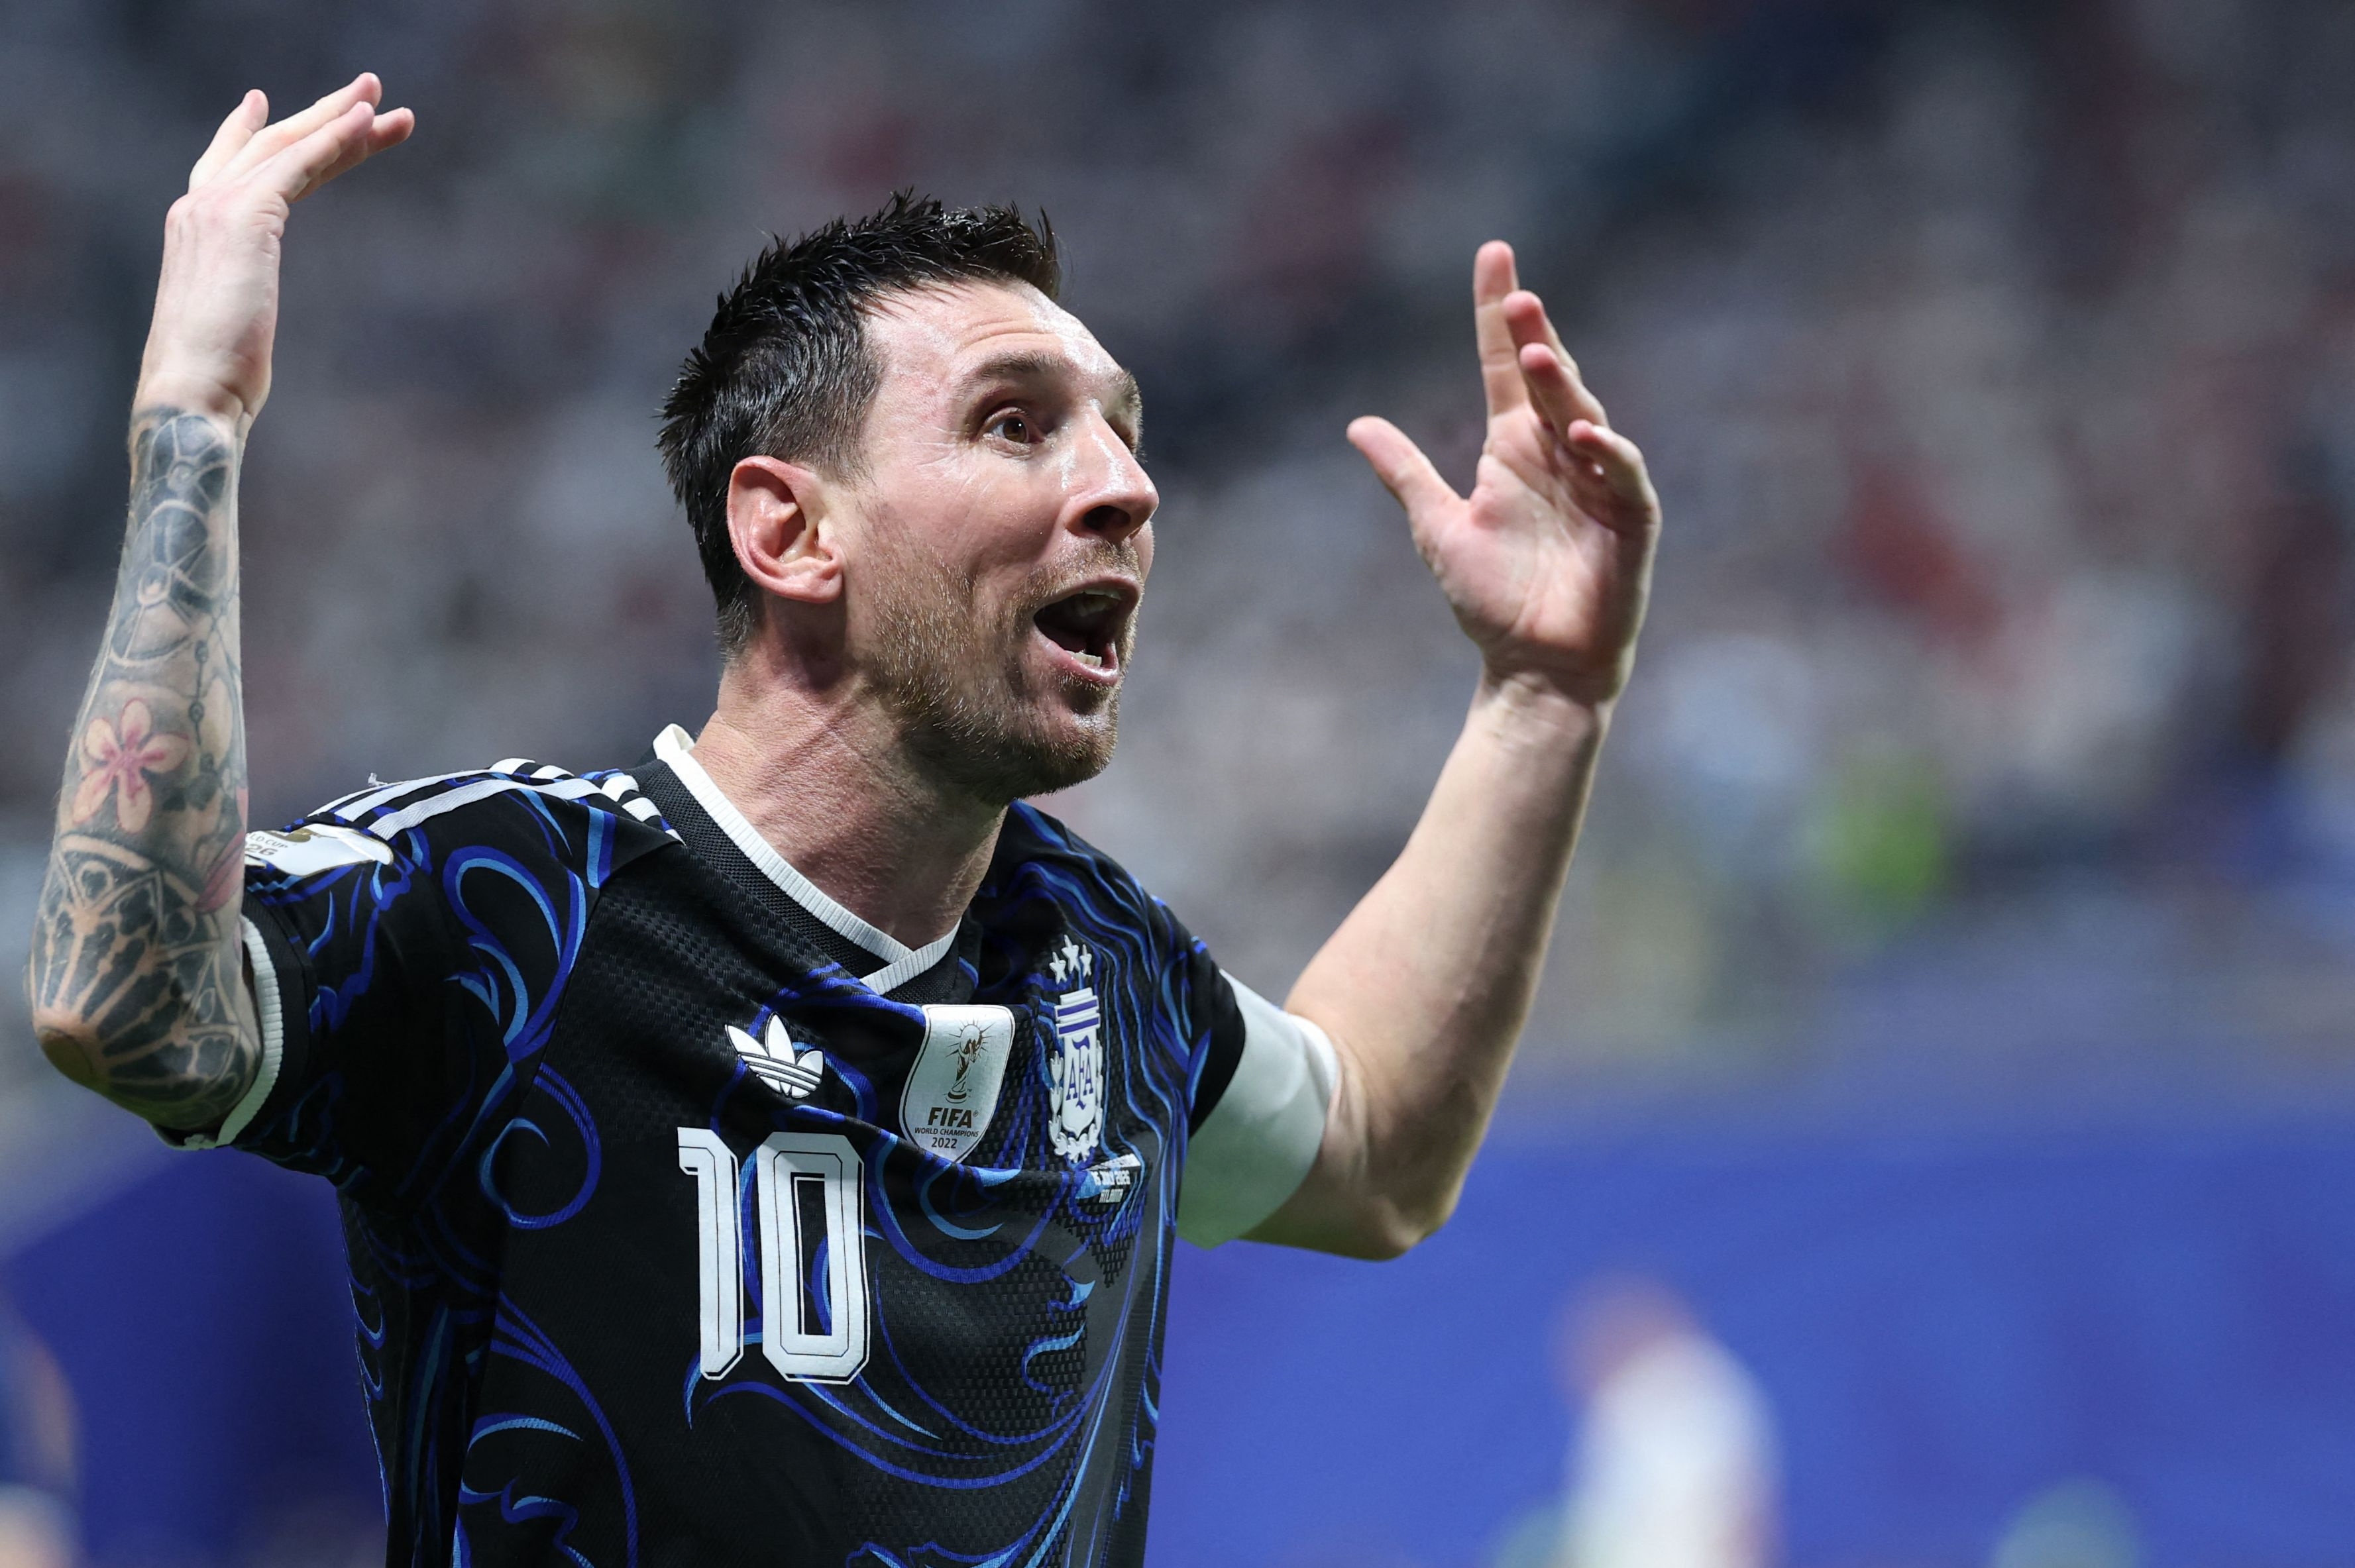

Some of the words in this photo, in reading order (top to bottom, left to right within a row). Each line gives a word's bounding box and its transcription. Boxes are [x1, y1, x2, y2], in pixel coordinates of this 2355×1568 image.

[245, 844, 278, 856] 26
[1066, 1035, 1093, 1110] AFA
[940, 1128, 979, 1137] CHAMPIONS
[931, 1137, 958, 1149] 2022
[677, 1127, 870, 1385] 10
